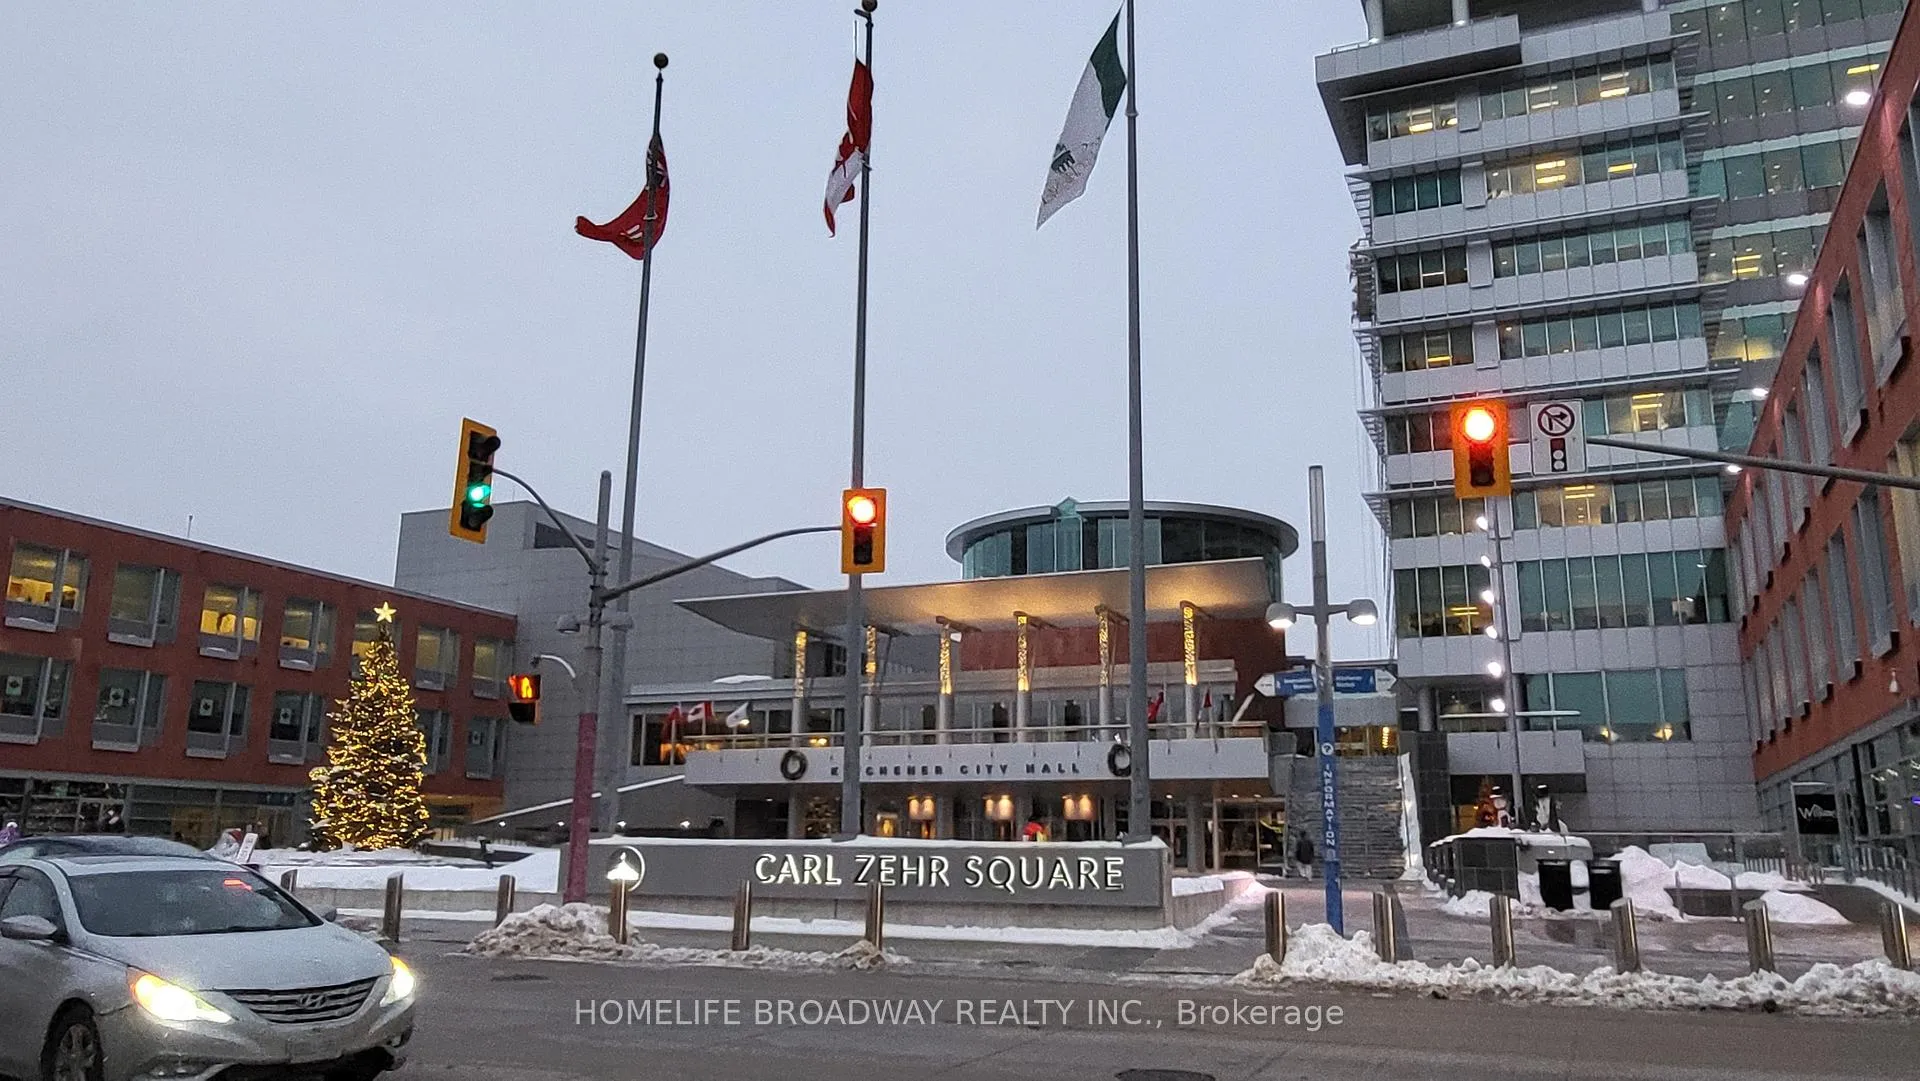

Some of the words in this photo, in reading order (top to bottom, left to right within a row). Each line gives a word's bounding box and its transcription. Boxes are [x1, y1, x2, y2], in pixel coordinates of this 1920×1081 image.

[830, 764, 944, 777] KCHENER
[959, 763, 1009, 776] CITY
[1025, 762, 1080, 775] HALL
[1323, 763, 1336, 847] INFORMATION
[754, 853, 843, 886] CARL
[853, 854, 950, 888] ZEHR
[964, 855, 1125, 895] SQUARE
